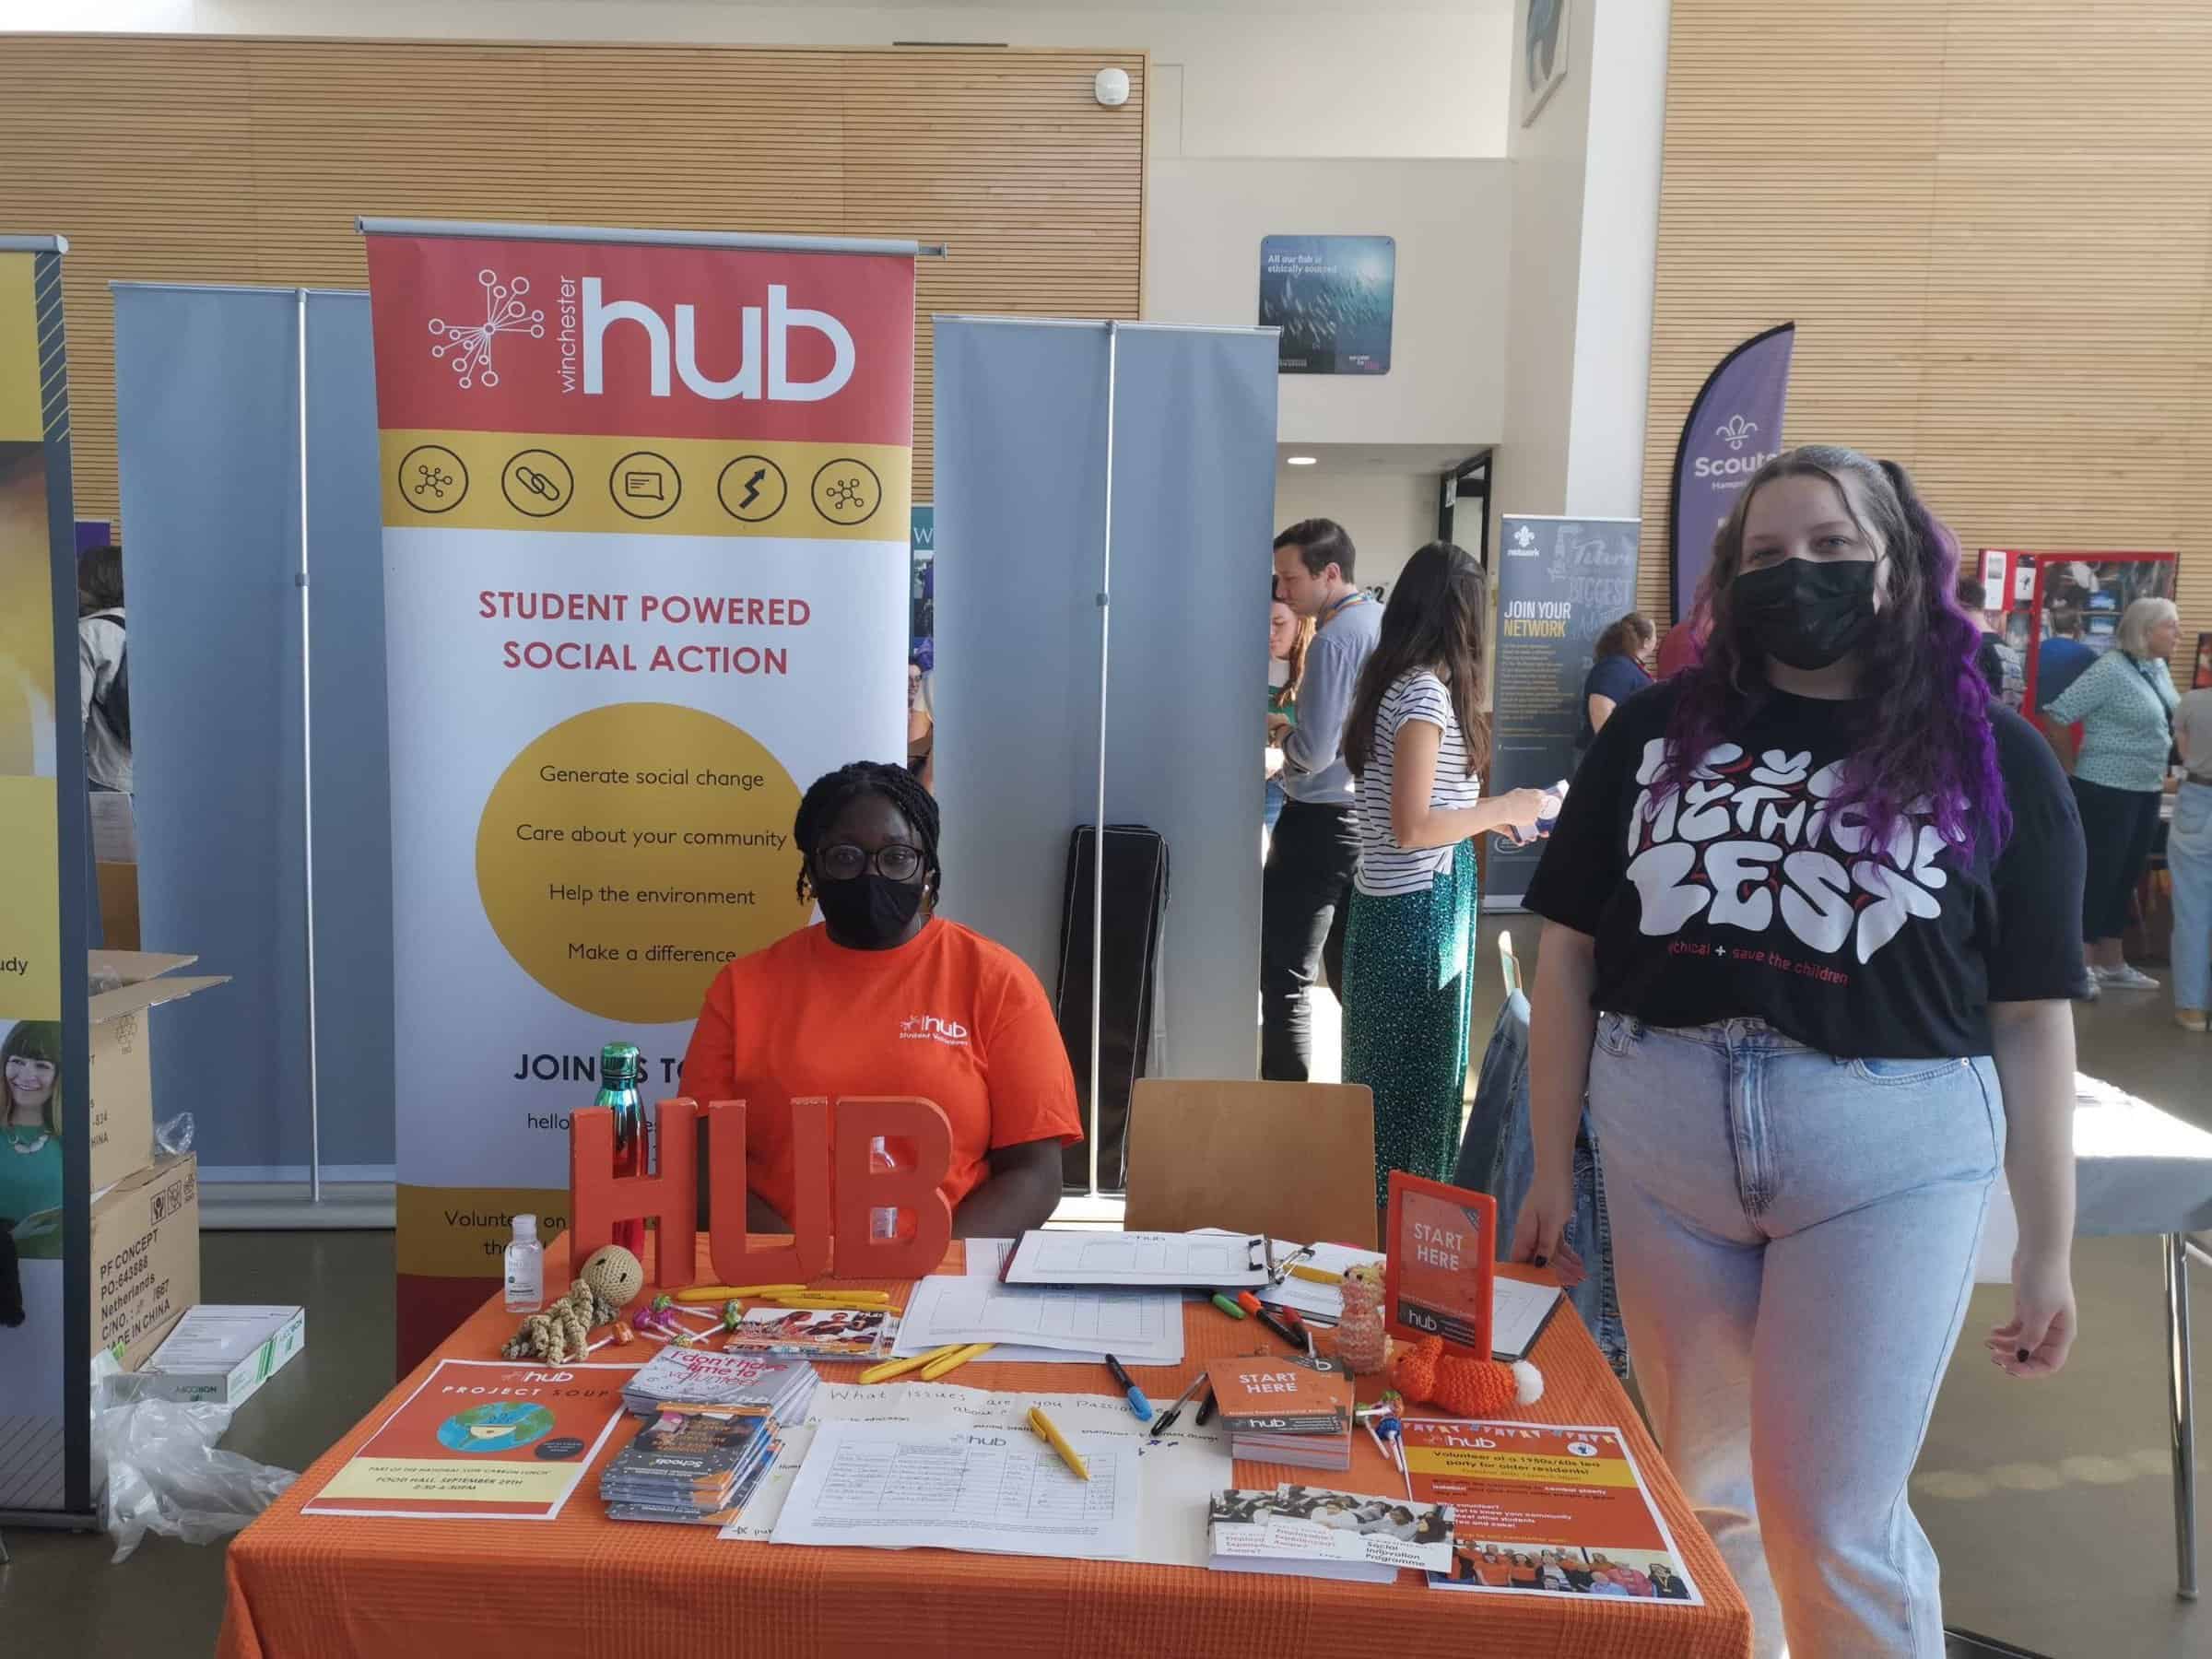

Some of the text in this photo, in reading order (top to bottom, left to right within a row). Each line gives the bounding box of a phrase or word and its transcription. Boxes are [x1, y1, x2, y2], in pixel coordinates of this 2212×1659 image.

[557, 275, 576, 394] winchester
[582, 276, 856, 402] hub
[478, 590, 811, 626] STUDENT POWERED
[1503, 601, 1571, 619] JOIN YOUR
[1503, 619, 1567, 639] NETWORK
[502, 640, 788, 675] SOCIAL ACTION
[539, 765, 765, 791] Generate social change
[516, 823, 788, 852] Care about your community
[548, 884, 756, 906] Help the environment
[568, 943, 736, 964] Make a difference
[1732, 947, 1765, 961] save
[1769, 952, 1791, 971] the
[1794, 959, 1849, 986] children
[924, 1015, 967, 1039] hub
[513, 1053, 595, 1082] JOIN
[570, 1094, 956, 1286] HUB
[1414, 1222, 1465, 1253] START
[100, 1229, 159, 1280] PF CONCEPT
[1416, 1244, 1460, 1272] HERE
[100, 1272, 156, 1322] Netherlands
[131, 1319, 142, 1335] IN
[142, 1298, 171, 1331] CHINA
[1408, 1309, 1438, 1332] hub
[524, 1371, 574, 1382] hub
[685, 1363, 758, 1379] time to
[1239, 1371, 1299, 1383] START
[441, 1385, 542, 1396] PROJECT
[552, 1389, 609, 1397] SOUP
[1247, 1382, 1299, 1394] HERE
[830, 1389, 886, 1401] What
[1033, 1400, 1063, 1409] you
[1249, 1418, 1286, 1429] hub
[968, 1435, 1006, 1446] hub
[1447, 1434, 1497, 1449] hub
[1433, 1451, 1489, 1460] Volunteer
[1445, 1460, 1477, 1468] party
[1498, 1462, 1529, 1471] older
[1365, 1547, 1421, 1560] Innovation
[1366, 1540, 1399, 1550] Social
[1365, 1553, 1426, 1567] Programme
